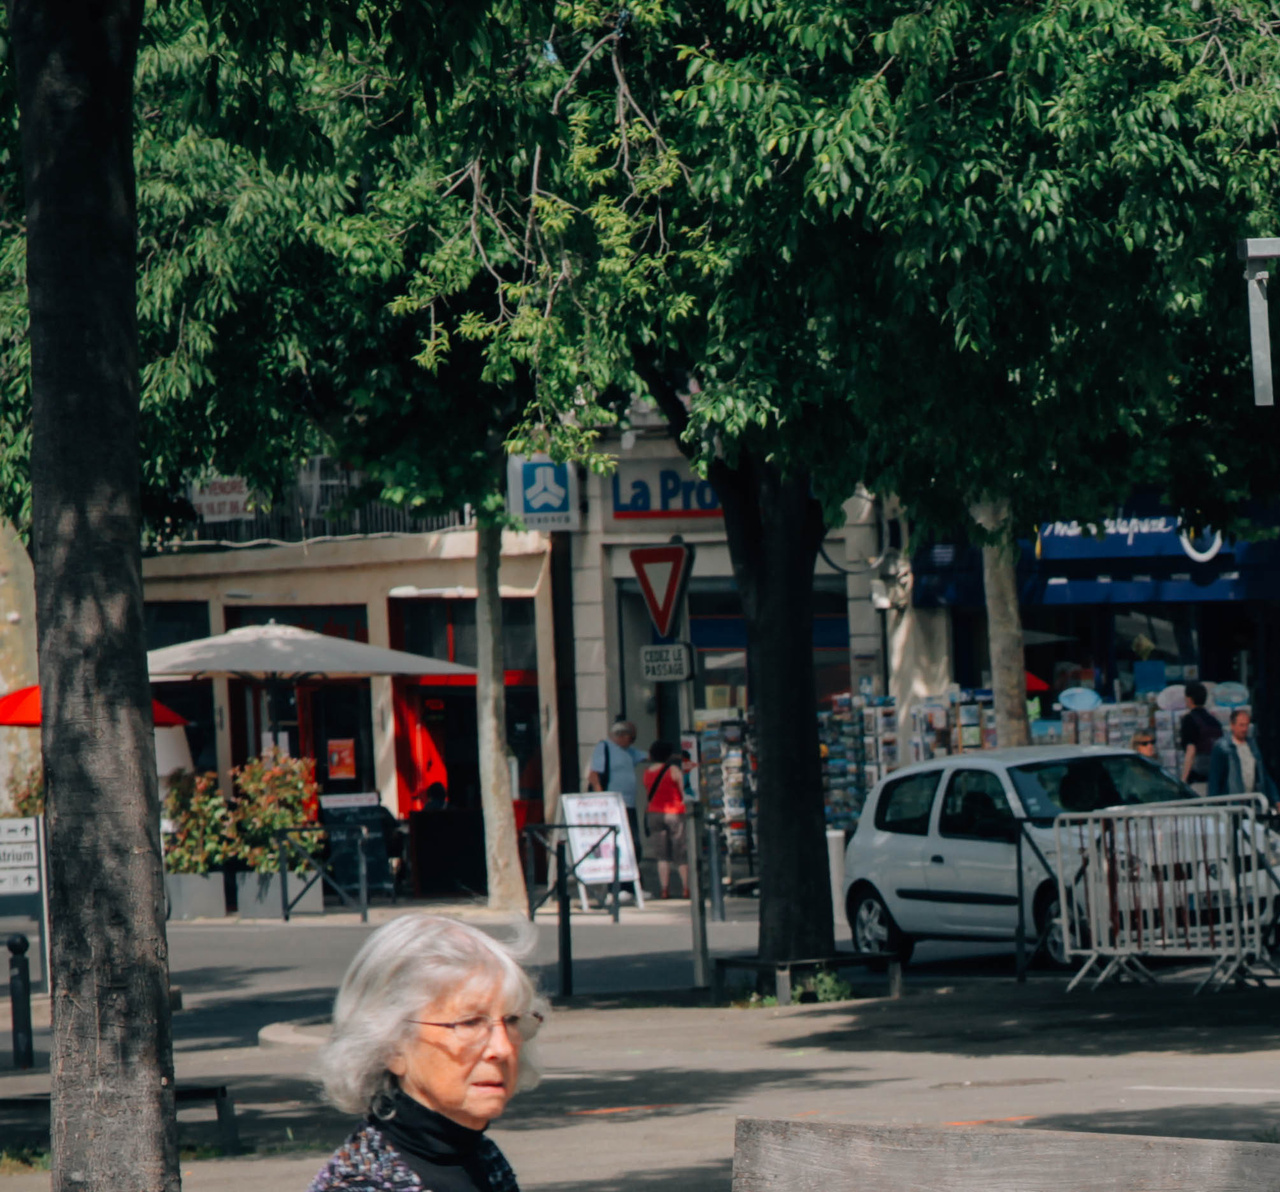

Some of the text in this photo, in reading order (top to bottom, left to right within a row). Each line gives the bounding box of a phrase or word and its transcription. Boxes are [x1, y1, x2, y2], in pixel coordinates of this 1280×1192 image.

[612, 471, 651, 511] La
[673, 649, 683, 661] LE
[645, 662, 684, 676] PASSAGE
